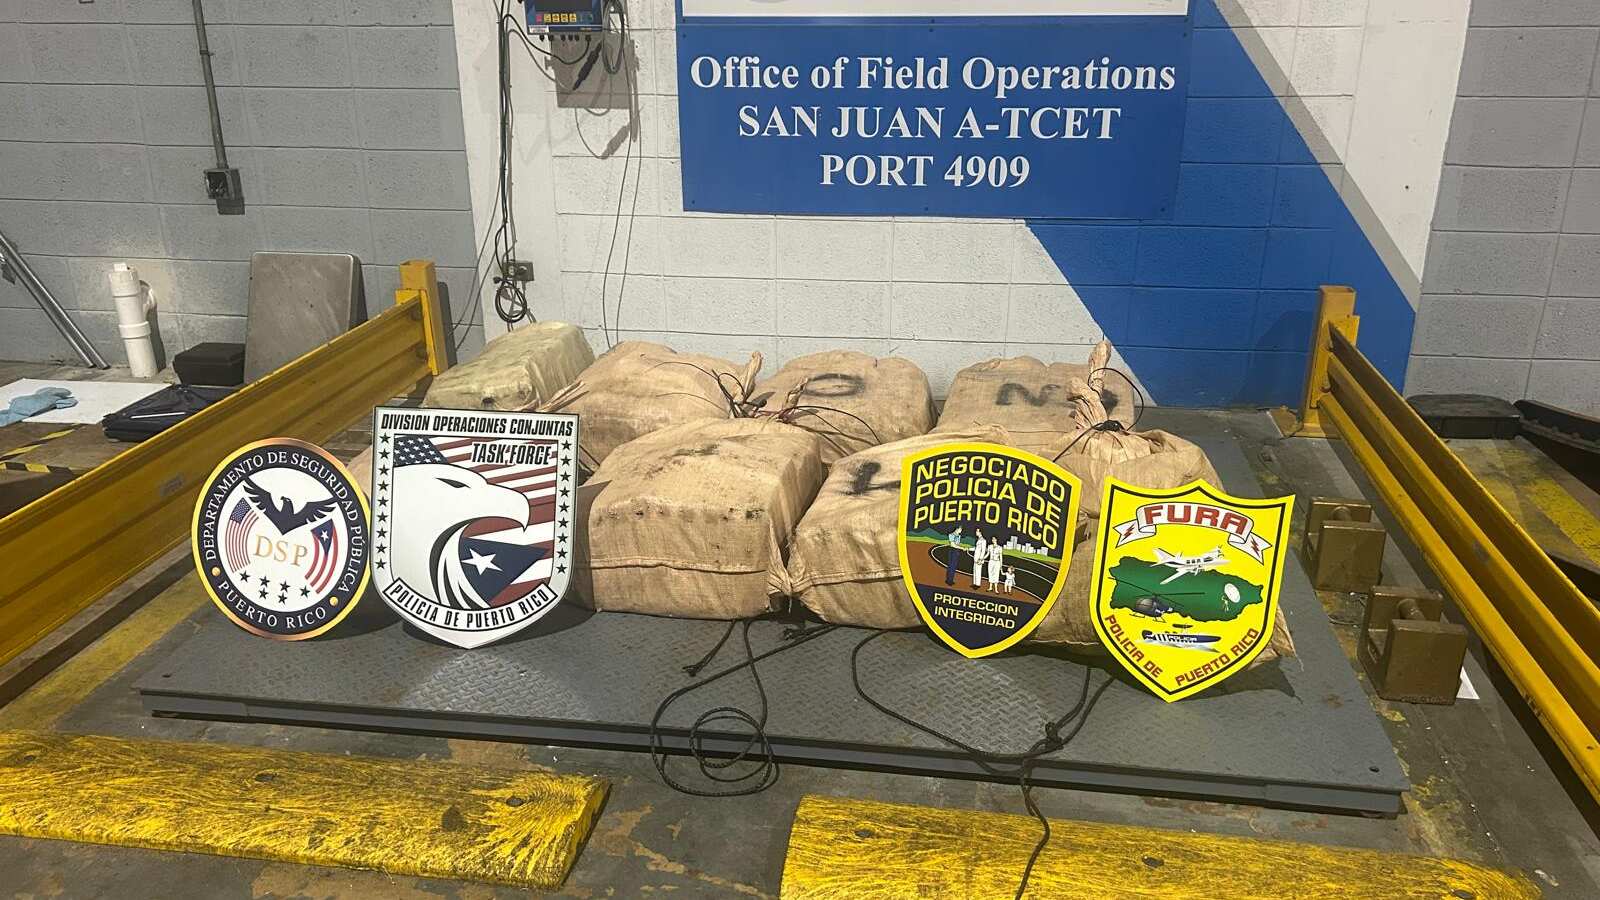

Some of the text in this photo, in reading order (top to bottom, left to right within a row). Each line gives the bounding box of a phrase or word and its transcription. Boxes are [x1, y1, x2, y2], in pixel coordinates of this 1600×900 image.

[690, 56, 1176, 97] Office of Field Operations
[739, 105, 1121, 140] SAN JUAN A-TCET
[819, 154, 1030, 188] PORT 4909
[381, 413, 574, 437] DIVISION OPERACIONES CONJUNTAS
[472, 443, 552, 465] TASK FORCE
[916, 455, 1065, 503] NEGOCIADO
[203, 451, 365, 593] DEPARTAMENTO DE SEGURIDAD PÚBLICA
[915, 476, 1017, 505] POLICIA
[1026, 491, 1062, 528] DE
[1143, 504, 1248, 536] FURA
[913, 500, 1058, 550] PUERTO RICO
[253, 534, 308, 567] DSP
[218, 580, 326, 629] PUERTO RICO
[389, 584, 550, 628] POLICIA DE PUERTO RICO
[934, 592, 1019, 616] PROTECCION
[934, 605, 1015, 629] INTEGRIDAD
[1104, 614, 1163, 678] POLICIA DE
[1175, 628, 1260, 687] PUERTO RICO
